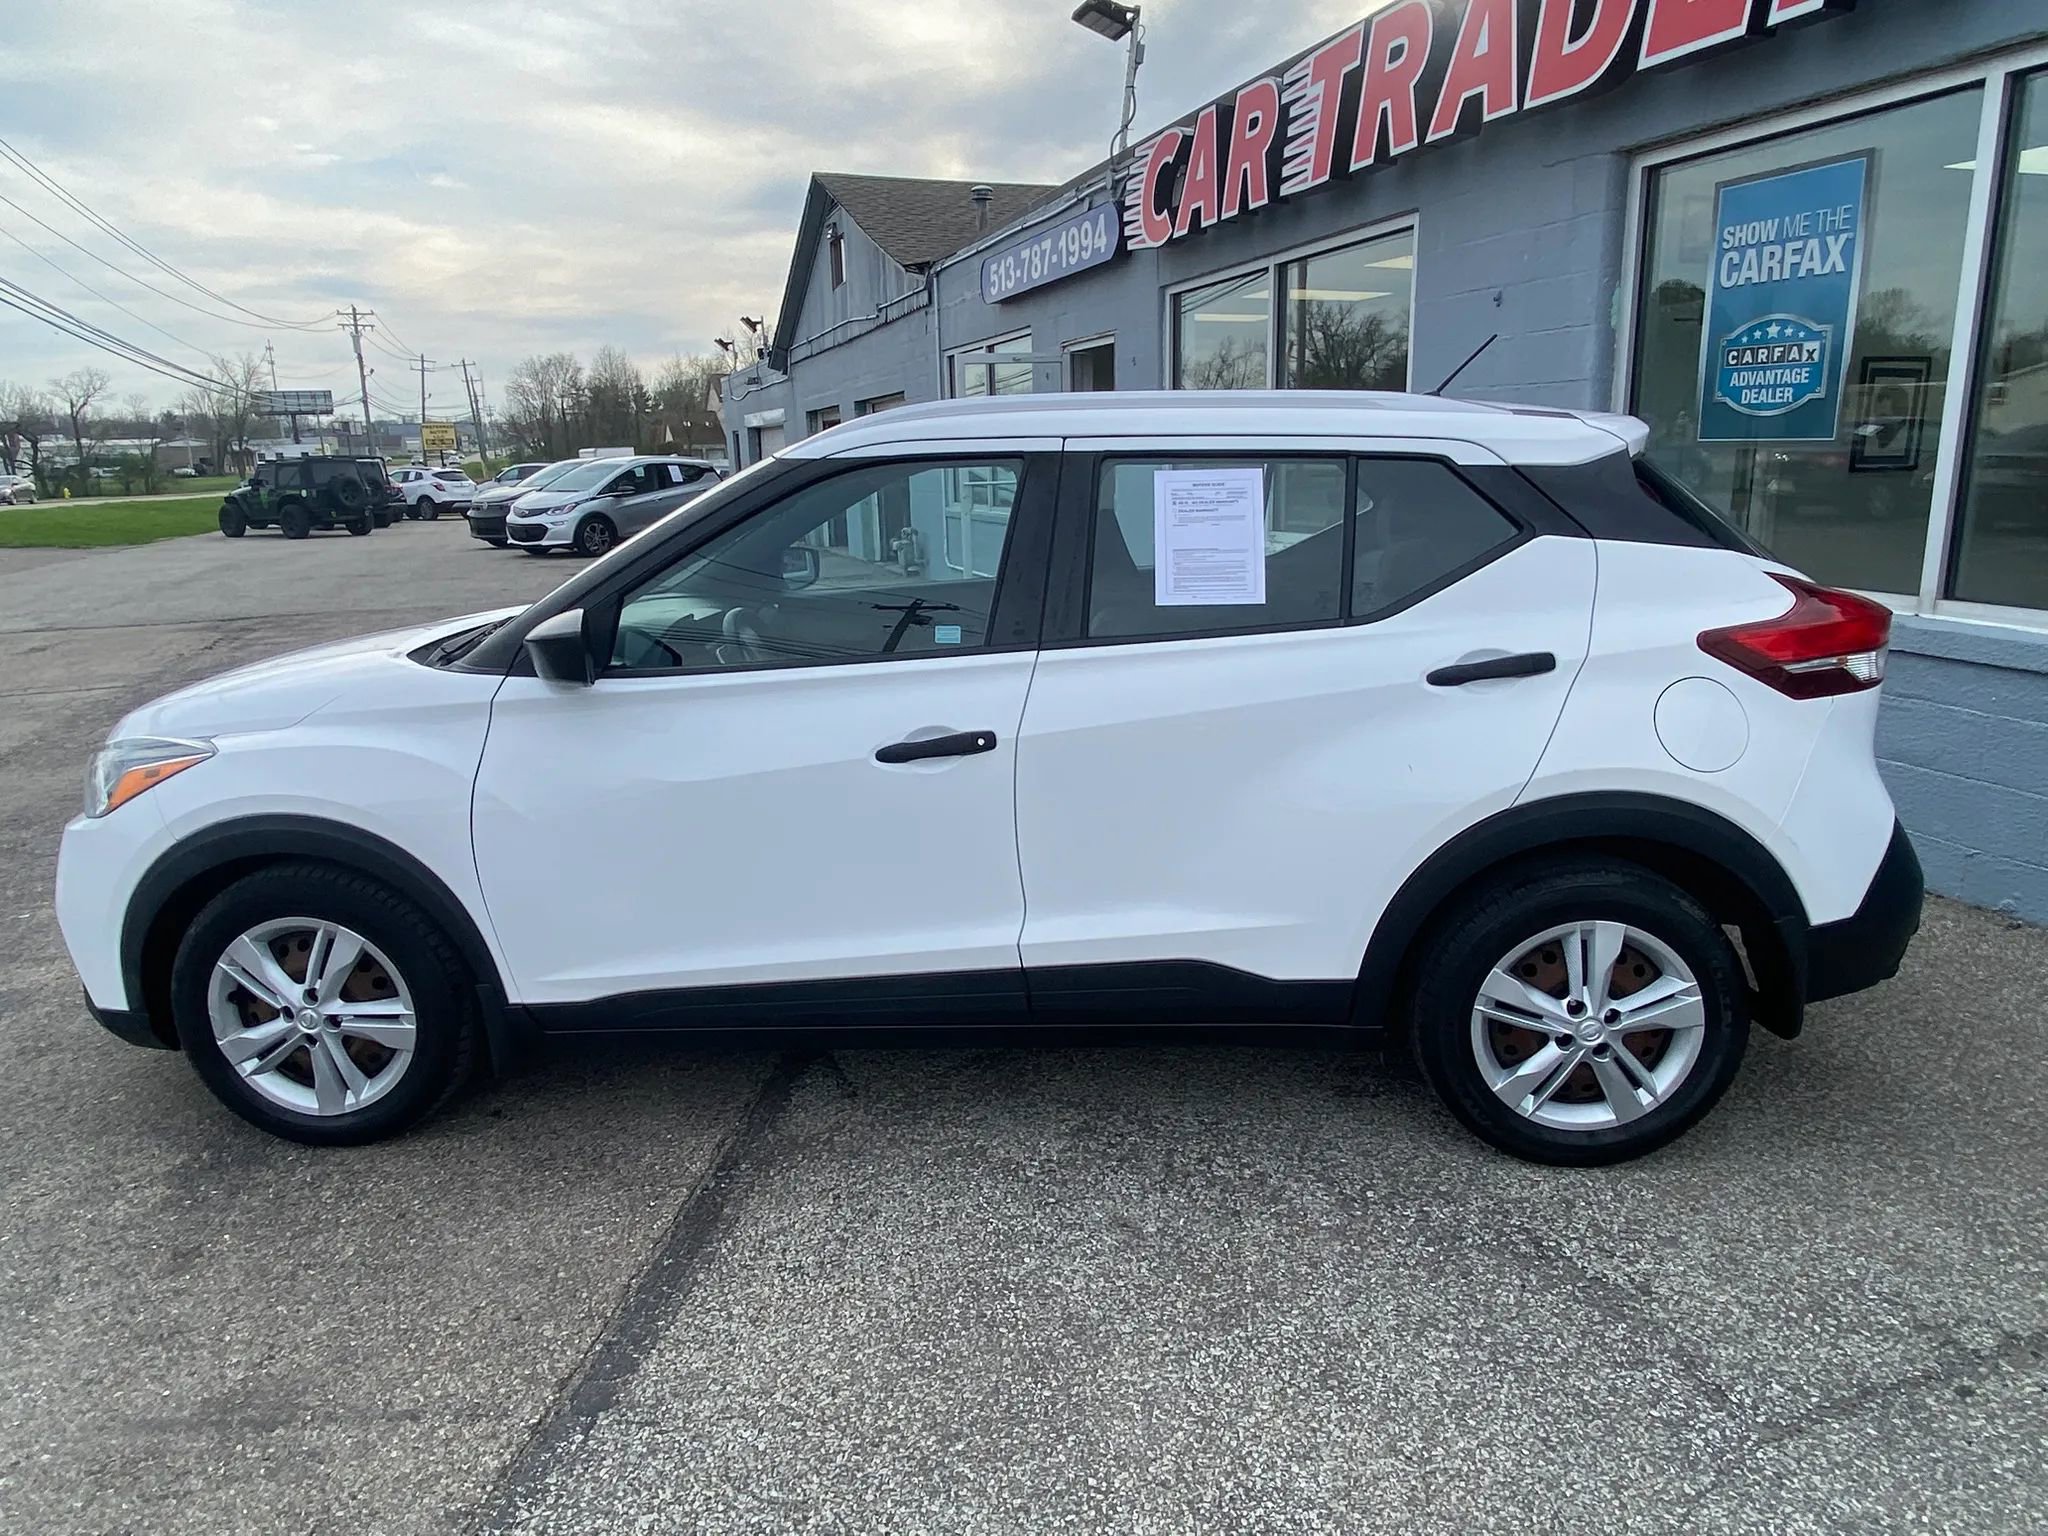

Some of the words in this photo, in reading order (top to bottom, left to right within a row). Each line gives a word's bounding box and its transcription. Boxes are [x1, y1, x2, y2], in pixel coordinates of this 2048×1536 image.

[1124, 76, 1280, 250] CAR
[1280, 0, 1825, 195] TRAD
[1722, 217, 1780, 250] SHOW
[1782, 211, 1813, 239] ME
[1816, 204, 1853, 233] THE
[989, 213, 1107, 296] 513-787-1994
[1719, 232, 1847, 289] CARFAX
[1728, 345, 1817, 365] CARFAX
[1729, 367, 1810, 387] ADVANTAGE
[1740, 386, 1794, 404] DEALER
